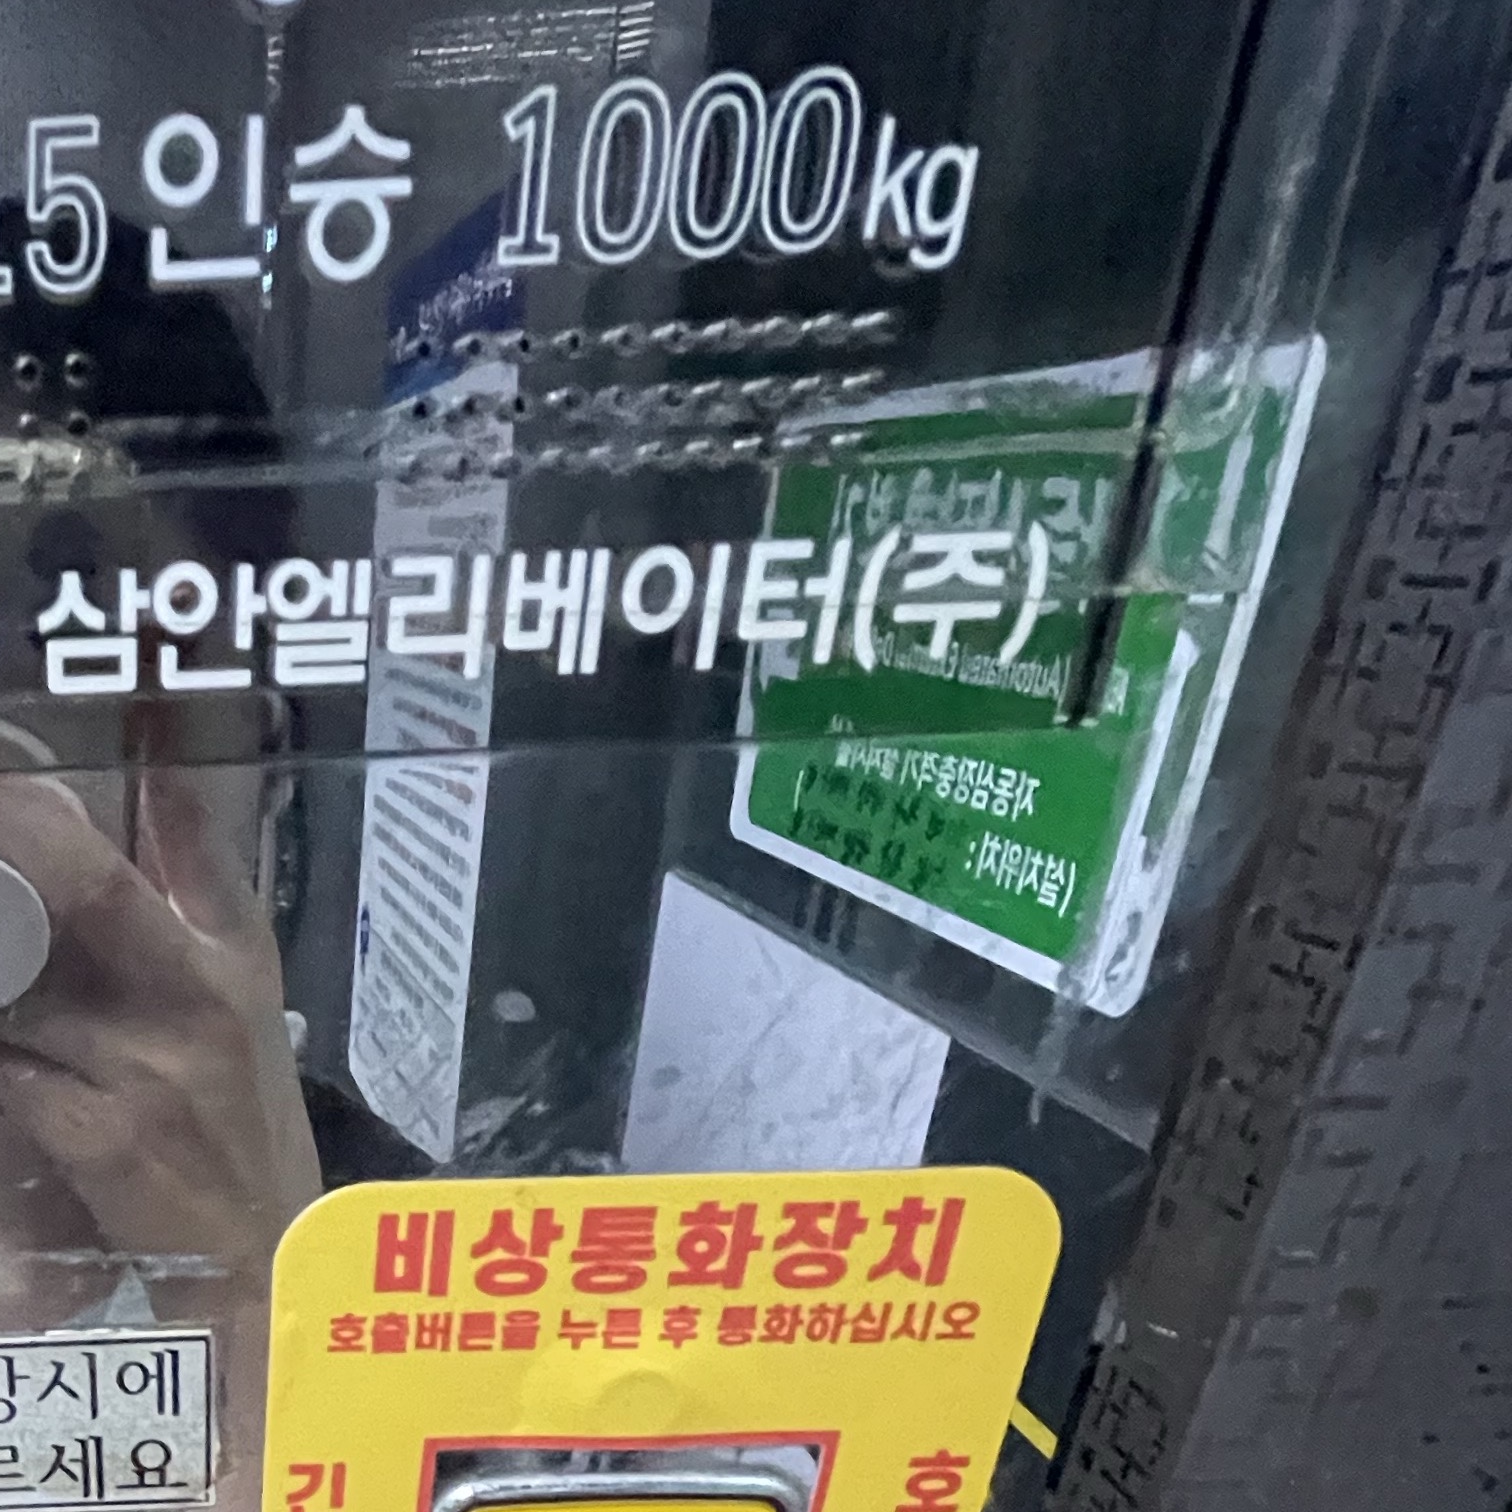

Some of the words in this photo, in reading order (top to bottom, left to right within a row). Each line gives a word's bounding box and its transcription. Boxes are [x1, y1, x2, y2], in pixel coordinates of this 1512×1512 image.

[37, 518, 1050, 695] 삼안엘리베이터(주)
[371, 1197, 967, 1298] 비상통화장치
[326, 1309, 542, 1355] 호출버튼을
[658, 1304, 698, 1347] 후
[716, 1300, 982, 1348] 통화하십시오
